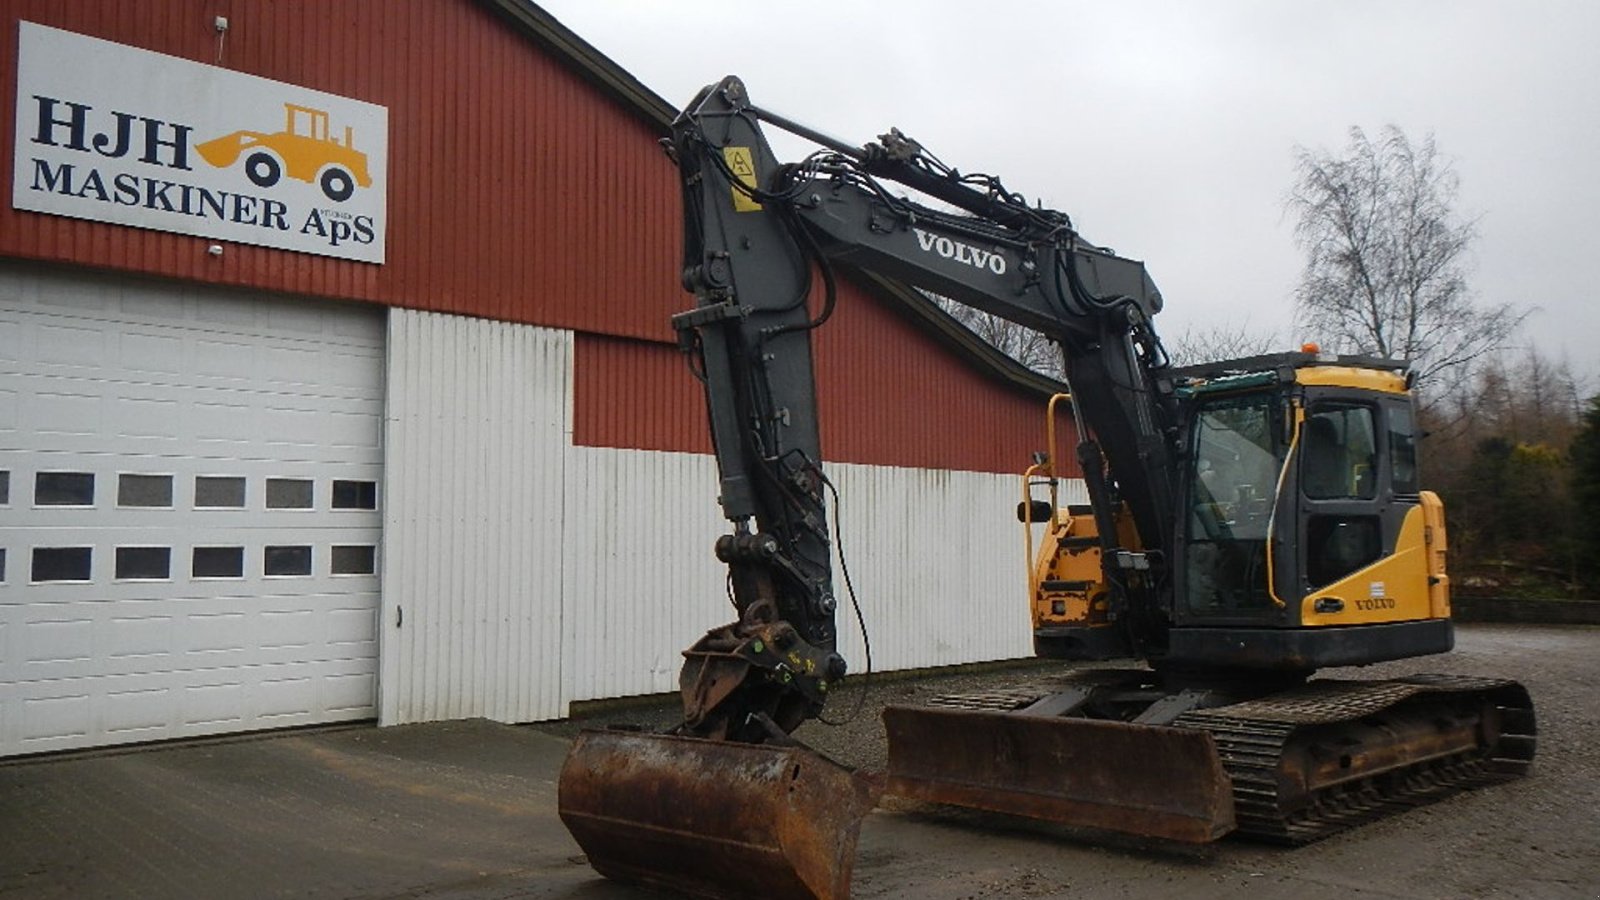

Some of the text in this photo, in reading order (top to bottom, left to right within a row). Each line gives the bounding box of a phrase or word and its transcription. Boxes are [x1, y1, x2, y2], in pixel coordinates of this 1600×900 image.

[30, 95, 193, 171] HJH
[30, 158, 374, 246] MASKINER ApS
[913, 228, 1006, 275] VOLVO
[1354, 599, 1395, 611] VOLVO
